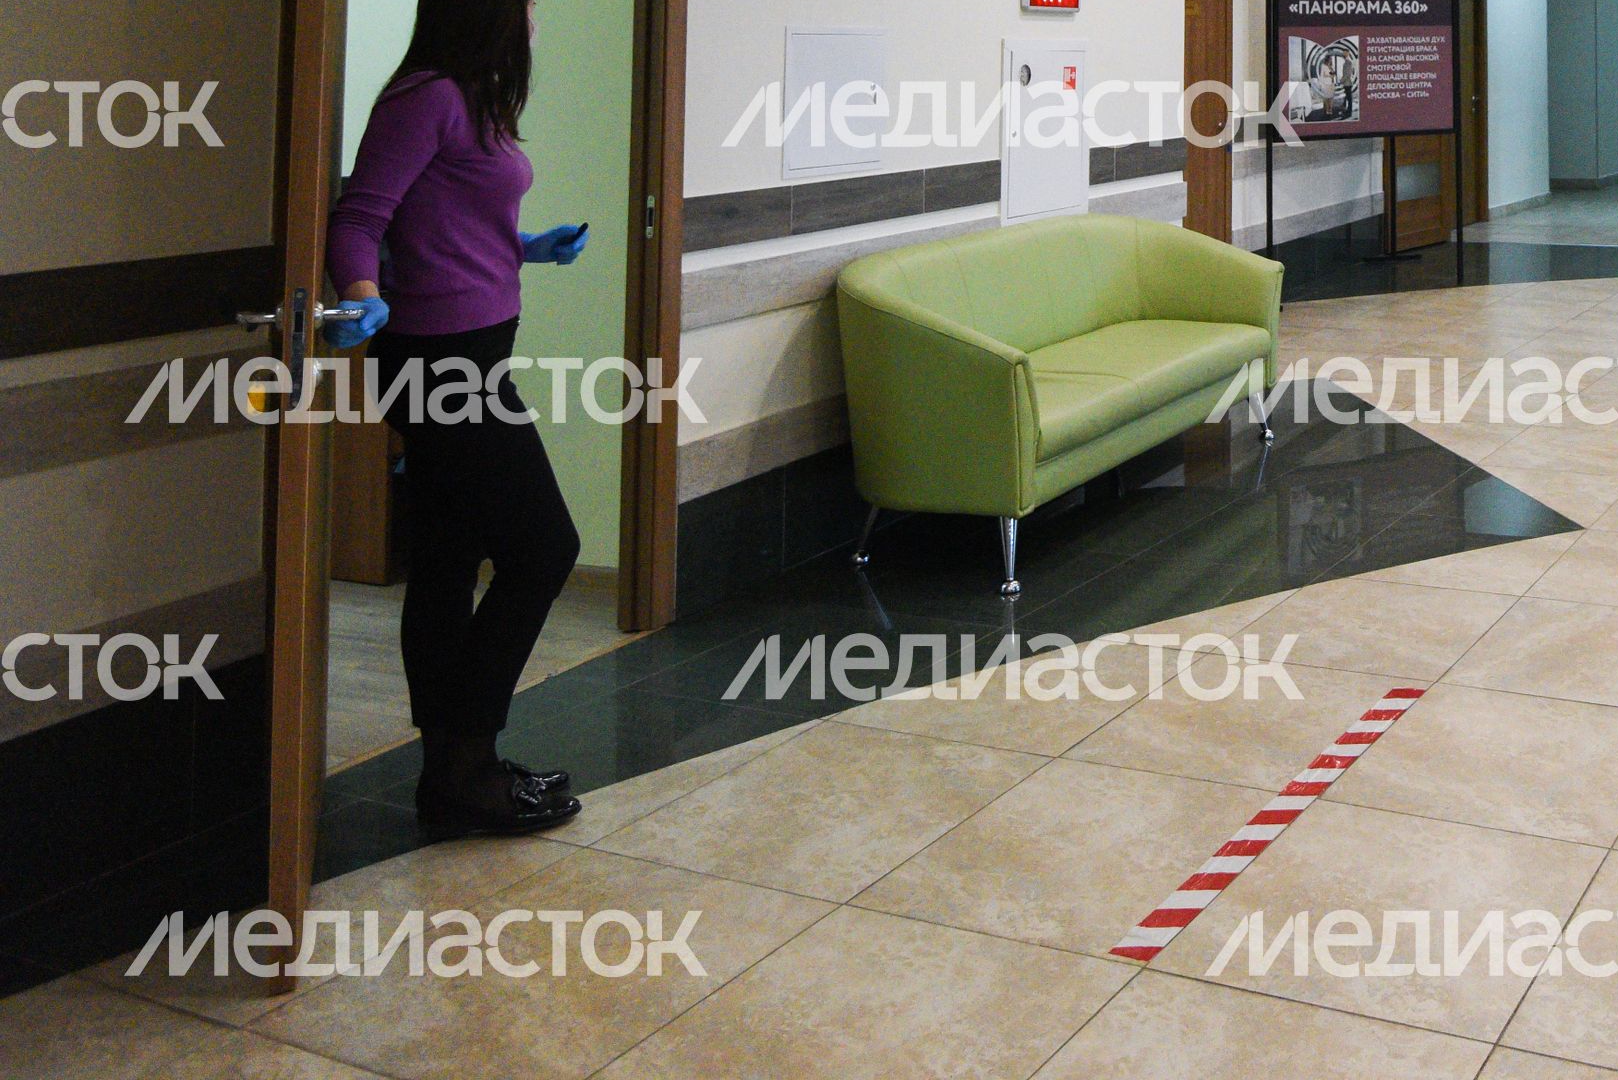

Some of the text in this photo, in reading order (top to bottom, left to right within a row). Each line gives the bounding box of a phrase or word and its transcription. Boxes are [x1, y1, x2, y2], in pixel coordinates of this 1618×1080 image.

[1289, 0, 1428, 15] «ПАНОРАМА 360»
[1366, 36, 1430, 44] ЗАХВАТЫВАЮЩАЯ
[1366, 45, 1415, 53] РЕГИСТРАЦИЯ
[1378, 54, 1405, 62] САМОЙ
[1406, 53, 1439, 61] ВЫСОКОЙ
[1366, 63, 1412, 71] СМОТРОВОЙ
[1366, 72, 1437, 81] ПЛОЩАДКЕ ЕВРОПЫ
[1366, 82, 1405, 90] ДЕЛОВОГО
